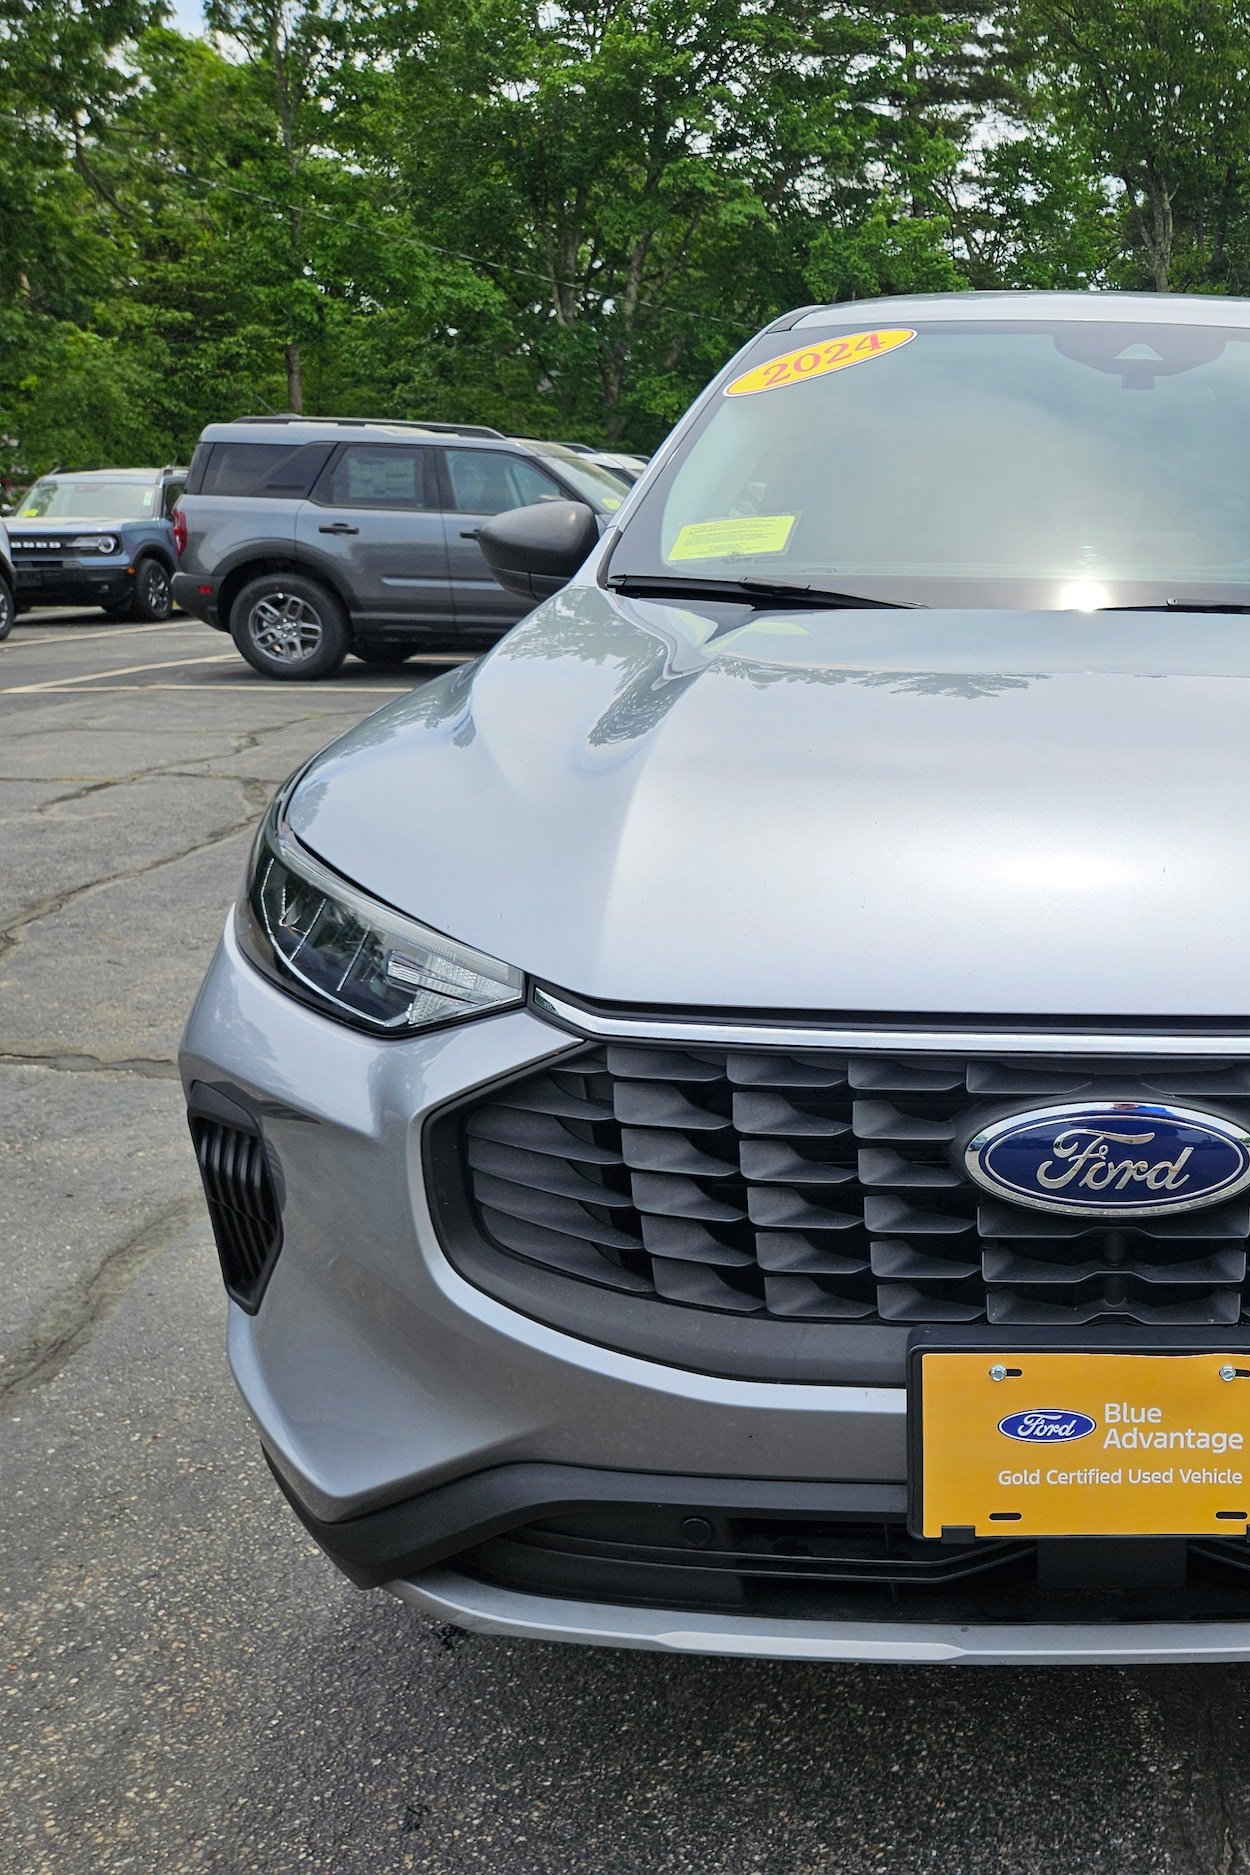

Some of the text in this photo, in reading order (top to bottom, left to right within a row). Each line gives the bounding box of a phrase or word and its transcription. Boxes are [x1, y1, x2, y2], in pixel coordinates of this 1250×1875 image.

[763, 333, 886, 387] 2024
[1035, 1128, 1194, 1191] Ford
[1017, 1413, 1077, 1438] Ford
[1103, 1402, 1163, 1424] Blue
[1103, 1428, 1244, 1454] Advantage
[998, 1468, 1243, 1486] Gold Certified Used Vehicle
